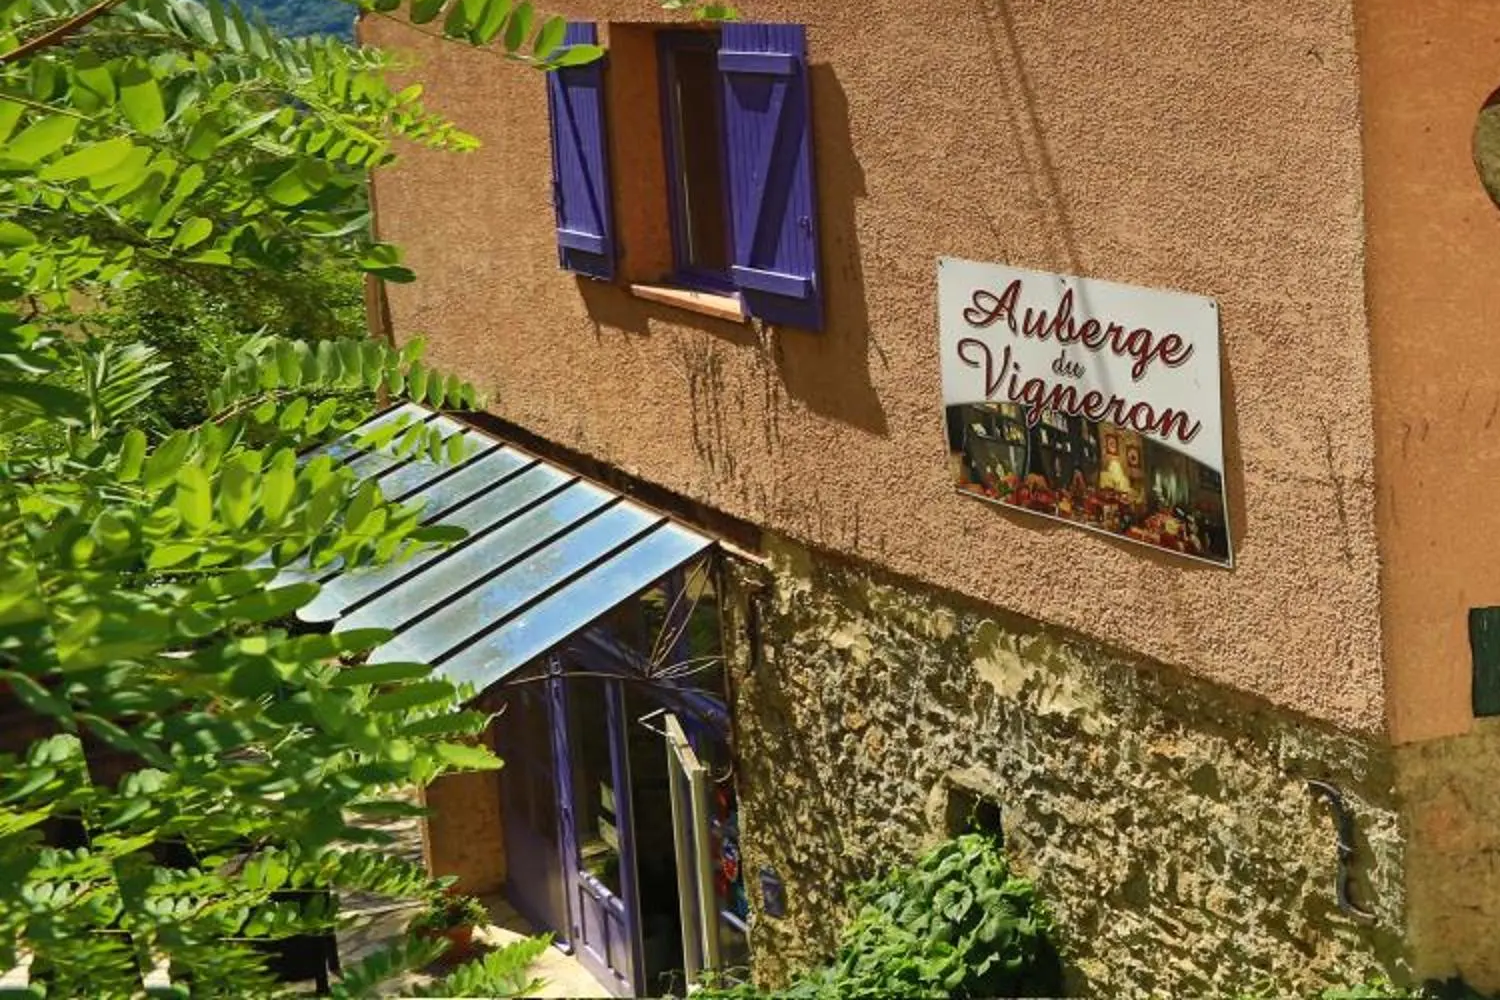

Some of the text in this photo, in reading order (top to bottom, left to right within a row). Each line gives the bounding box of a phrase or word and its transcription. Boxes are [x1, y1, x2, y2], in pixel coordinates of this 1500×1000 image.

[963, 279, 1193, 382] Auberge
[1051, 350, 1086, 379] du
[957, 338, 1201, 442] Vigneron
